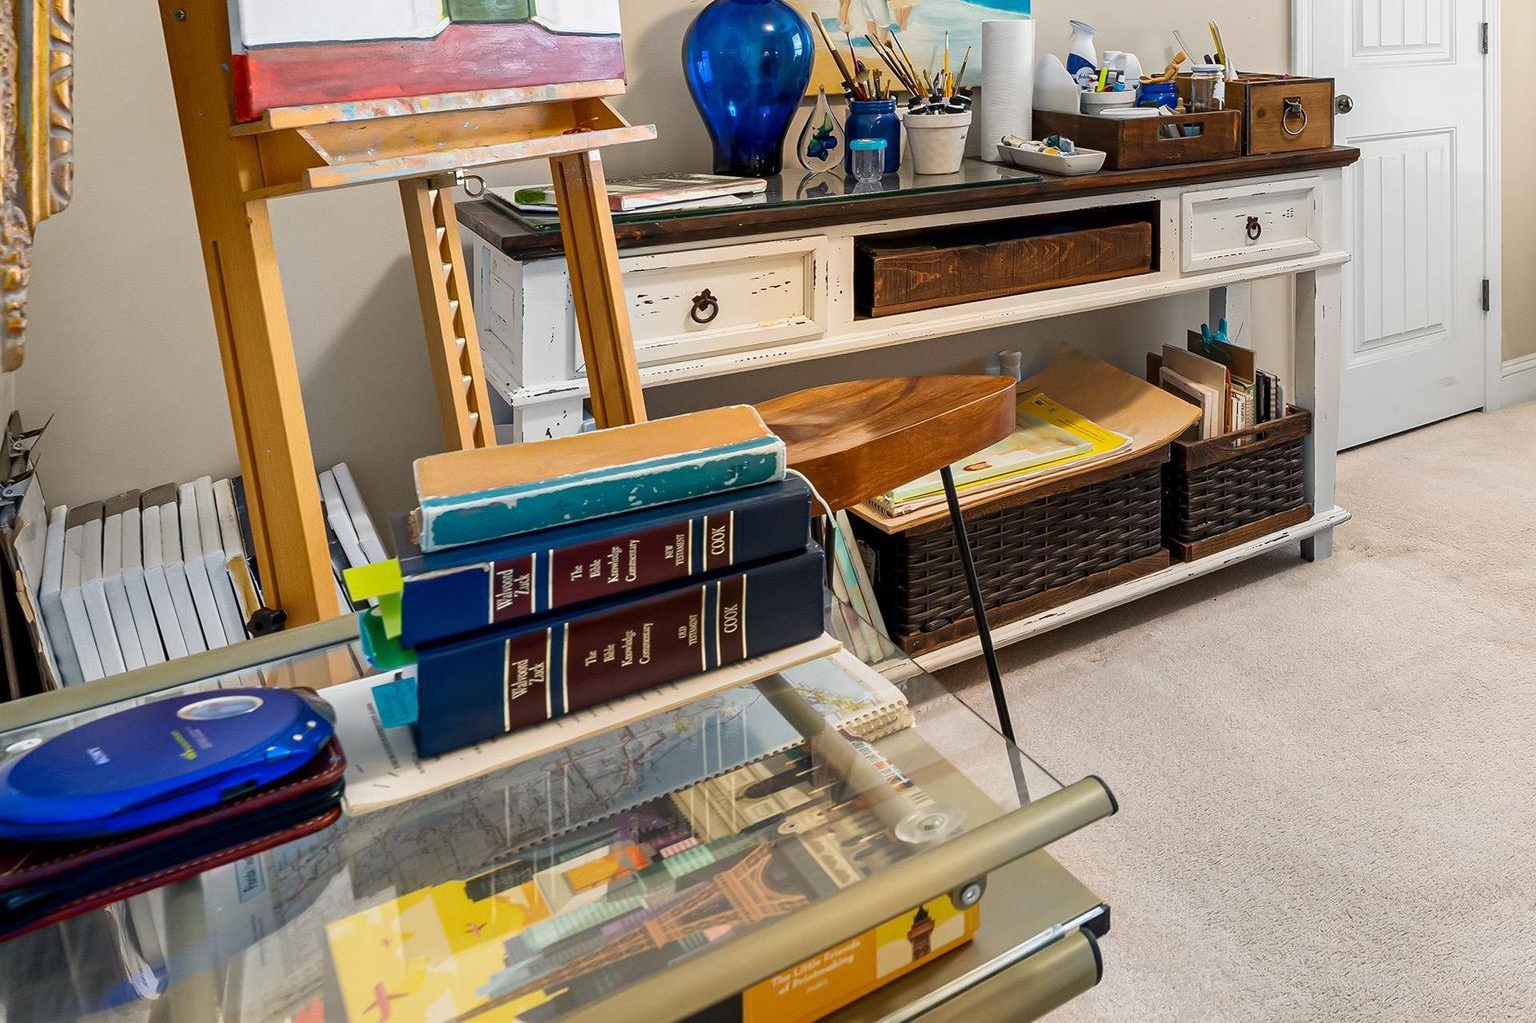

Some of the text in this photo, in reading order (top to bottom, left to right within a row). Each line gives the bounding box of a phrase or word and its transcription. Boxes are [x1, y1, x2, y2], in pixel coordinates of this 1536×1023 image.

[665, 545, 674, 560] NEW
[675, 533, 685, 567] TESTAMENT
[711, 525, 725, 556] COOK
[571, 564, 583, 582] The
[589, 559, 601, 579] Bible
[608, 546, 623, 584] Knowledge
[626, 539, 640, 582] Commentary
[497, 568, 514, 611] Walvoord
[514, 573, 530, 598] Zuck
[678, 626, 687, 639] OLD
[688, 613, 698, 647] TESTAMENT
[724, 603, 738, 634] COOK
[585, 649, 598, 667] The
[604, 643, 615, 663] Bible
[622, 629, 636, 668] Knowledge
[639, 622, 654, 665] Commentary
[511, 658, 529, 701] Walvoord
[529, 661, 545, 686] Zuck
[771, 974, 791, 988] The
[793, 958, 821, 976] Little
[824, 940, 860, 961] Friends
[792, 954, 854, 989] Printmaking
